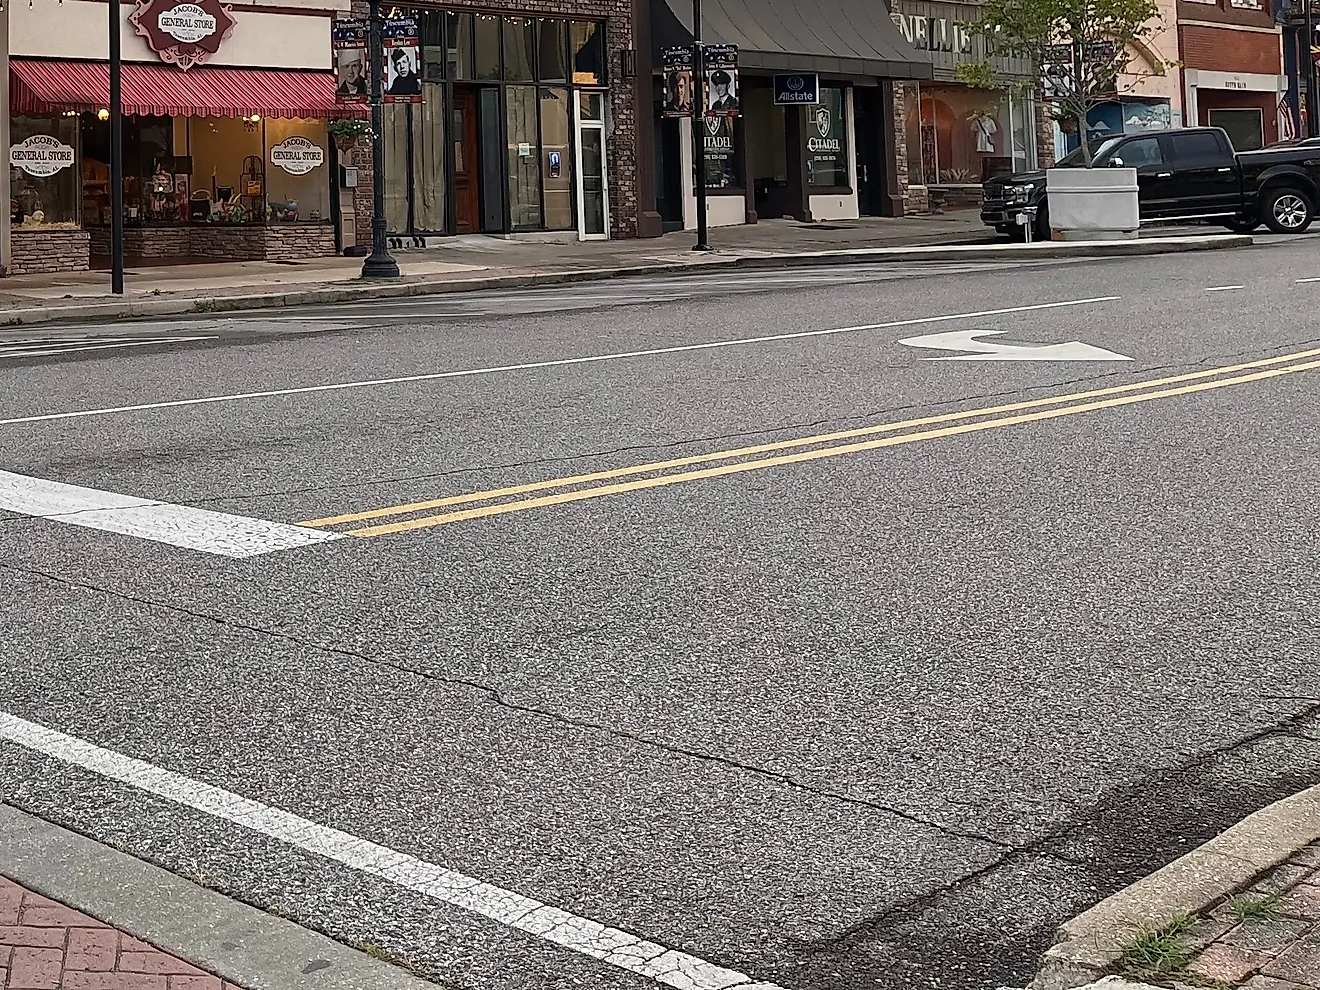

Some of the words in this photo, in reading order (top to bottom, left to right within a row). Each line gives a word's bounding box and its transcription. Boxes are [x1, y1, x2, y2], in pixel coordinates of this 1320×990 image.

[161, 16, 193, 28] GENERAL
[193, 19, 214, 30] STORE
[889, 12, 973, 55] NELLIE
[778, 91, 813, 101] Allstate
[24, 136, 60, 149] JACOB'S
[282, 138, 311, 149] JACOB'S
[703, 136, 733, 148] ITADEL
[11, 150, 48, 161] GENERAL
[48, 150, 72, 161] STORE
[273, 150, 302, 161] GENERAL
[302, 151, 322, 161] STORE
